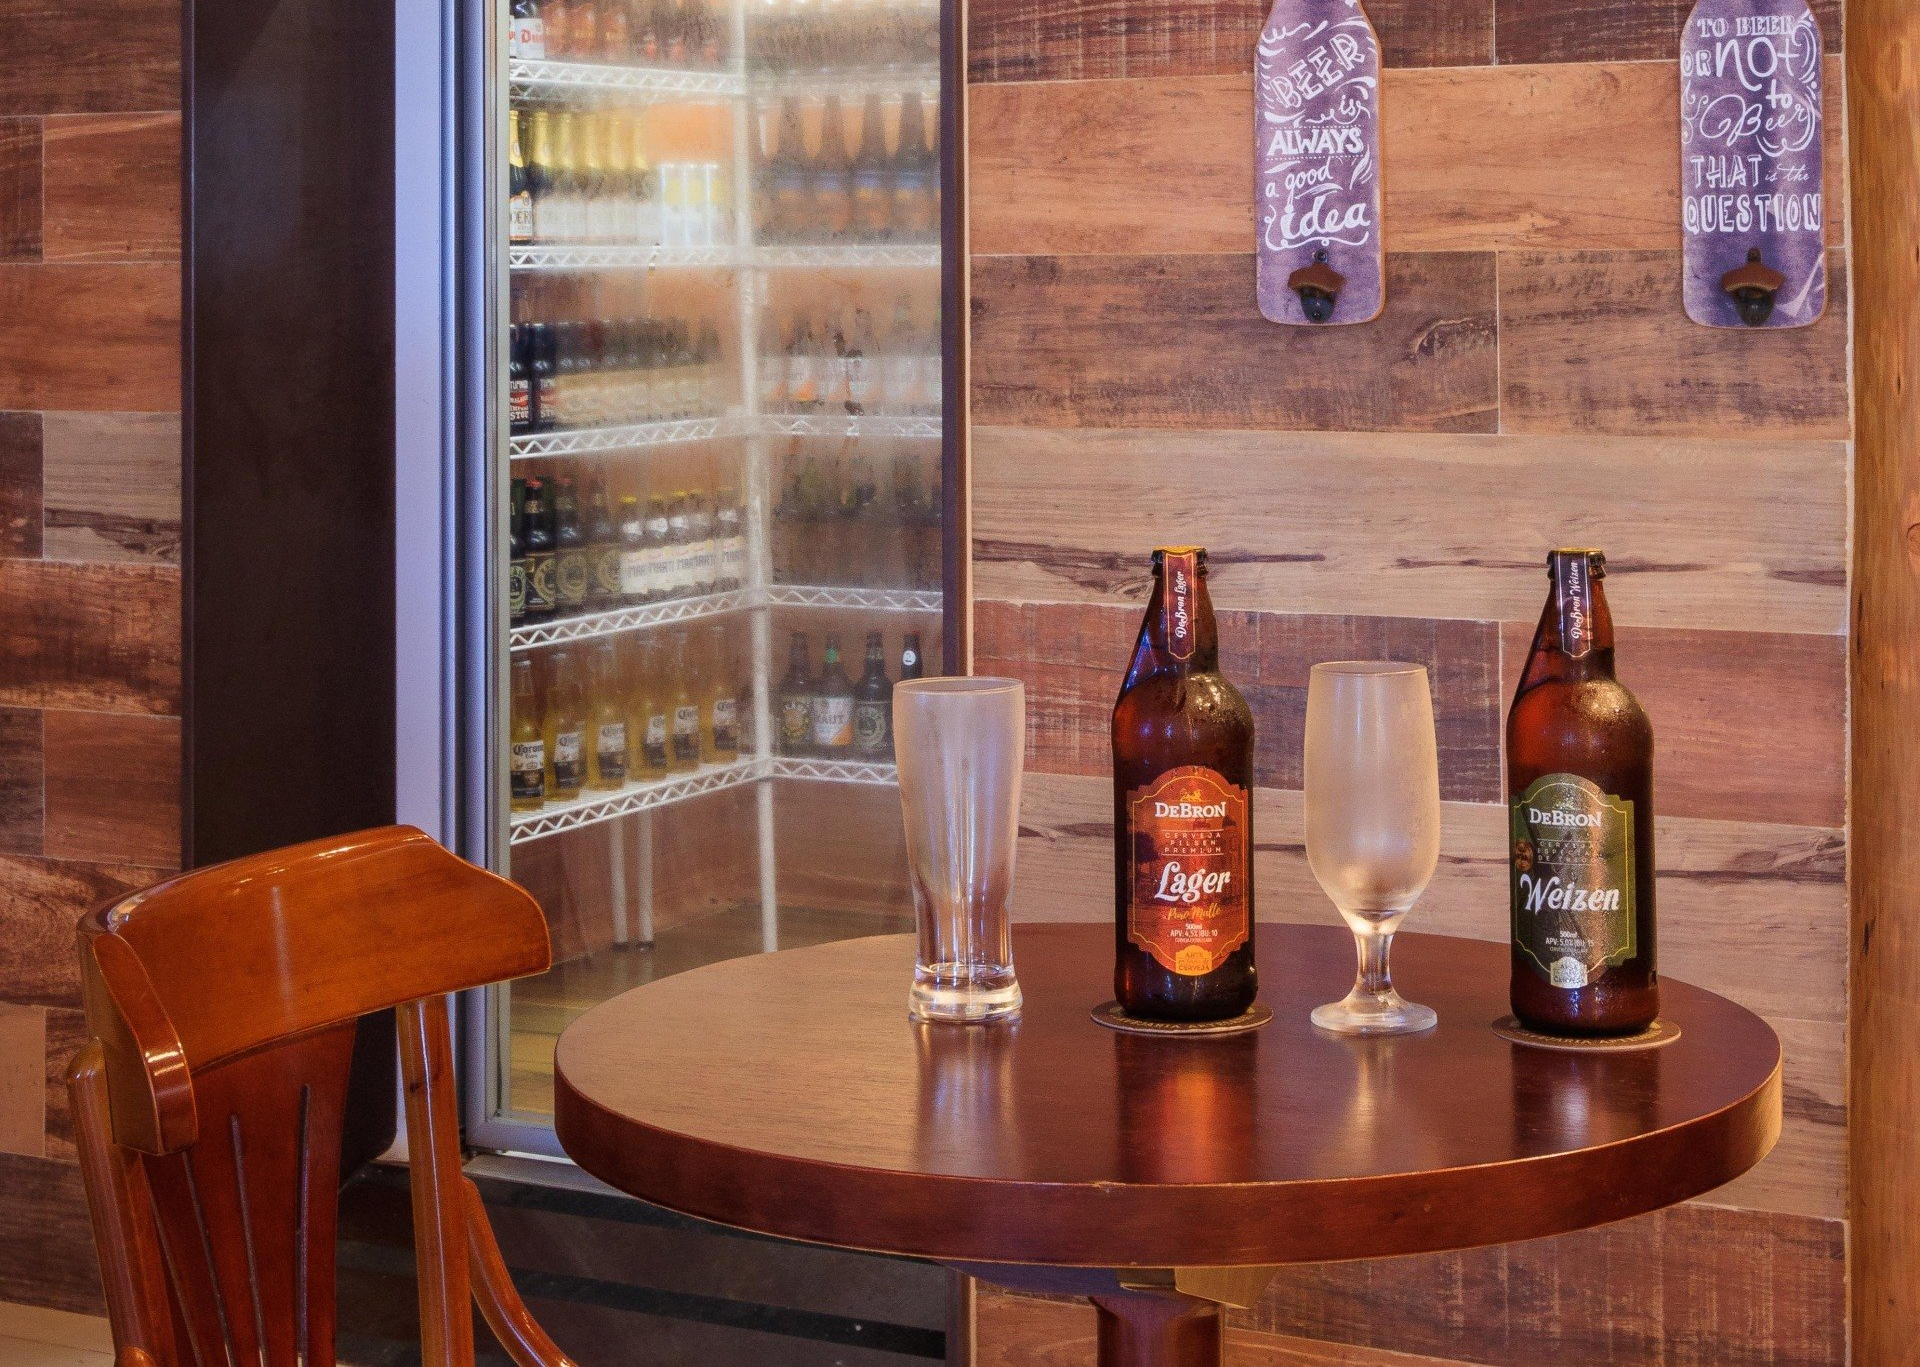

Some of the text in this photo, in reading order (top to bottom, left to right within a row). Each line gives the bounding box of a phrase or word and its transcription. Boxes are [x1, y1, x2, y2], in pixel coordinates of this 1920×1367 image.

[1697, 15, 1795, 38] TO BEER
[1269, 33, 1365, 109] BEER
[1682, 50, 1711, 77] OR
[1766, 78, 1793, 109] to
[1699, 94, 1808, 147] Beer
[1266, 127, 1364, 156] ALWAYS
[1265, 156, 1334, 210] a good
[1690, 154, 1810, 188] THAT is the
[1280, 193, 1371, 240] idea
[1683, 193, 1821, 235] QUESTION
[1173, 571, 1187, 595] Lager
[1568, 562, 1581, 597] Weizen
[1154, 861, 1231, 903] Lager
[1520, 873, 1620, 915] Weizen
